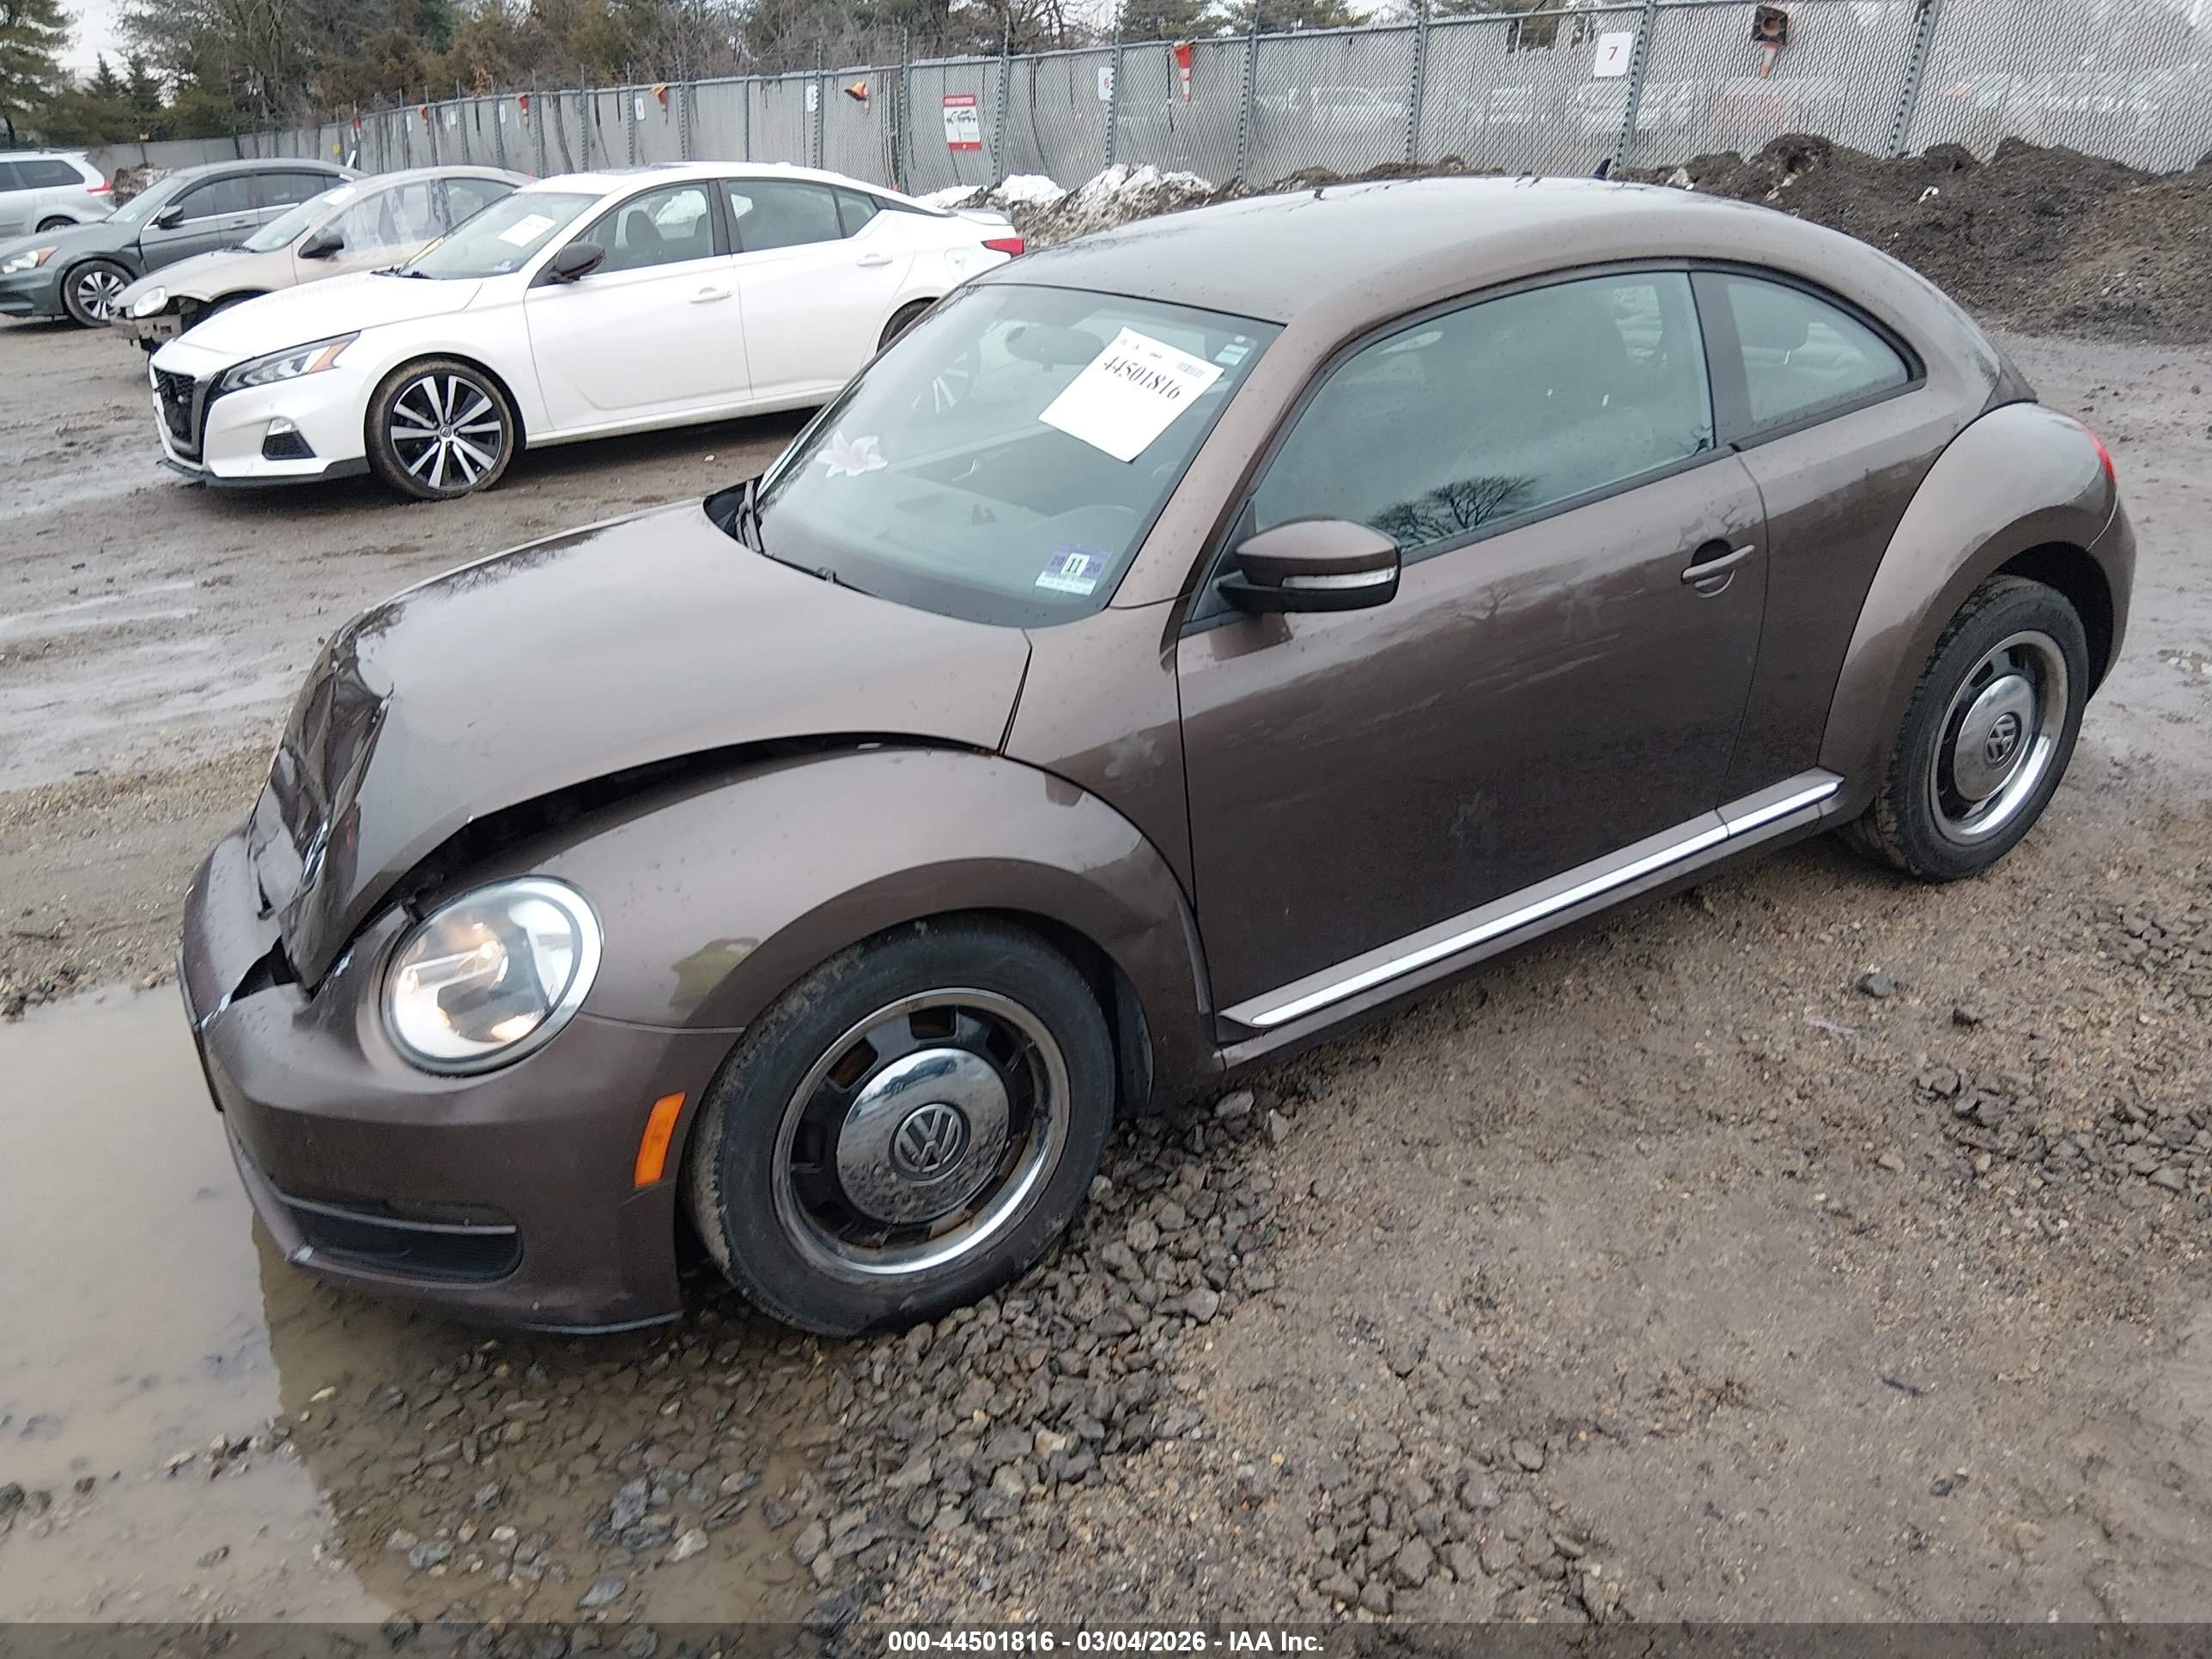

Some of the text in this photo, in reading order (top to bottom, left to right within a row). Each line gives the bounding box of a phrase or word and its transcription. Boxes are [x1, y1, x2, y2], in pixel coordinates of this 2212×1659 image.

[1609, 46, 1619, 61] 7
[1103, 356, 1183, 400] 44501816
[1066, 557, 1083, 573] 11
[895, 1104, 962, 1173] VW
